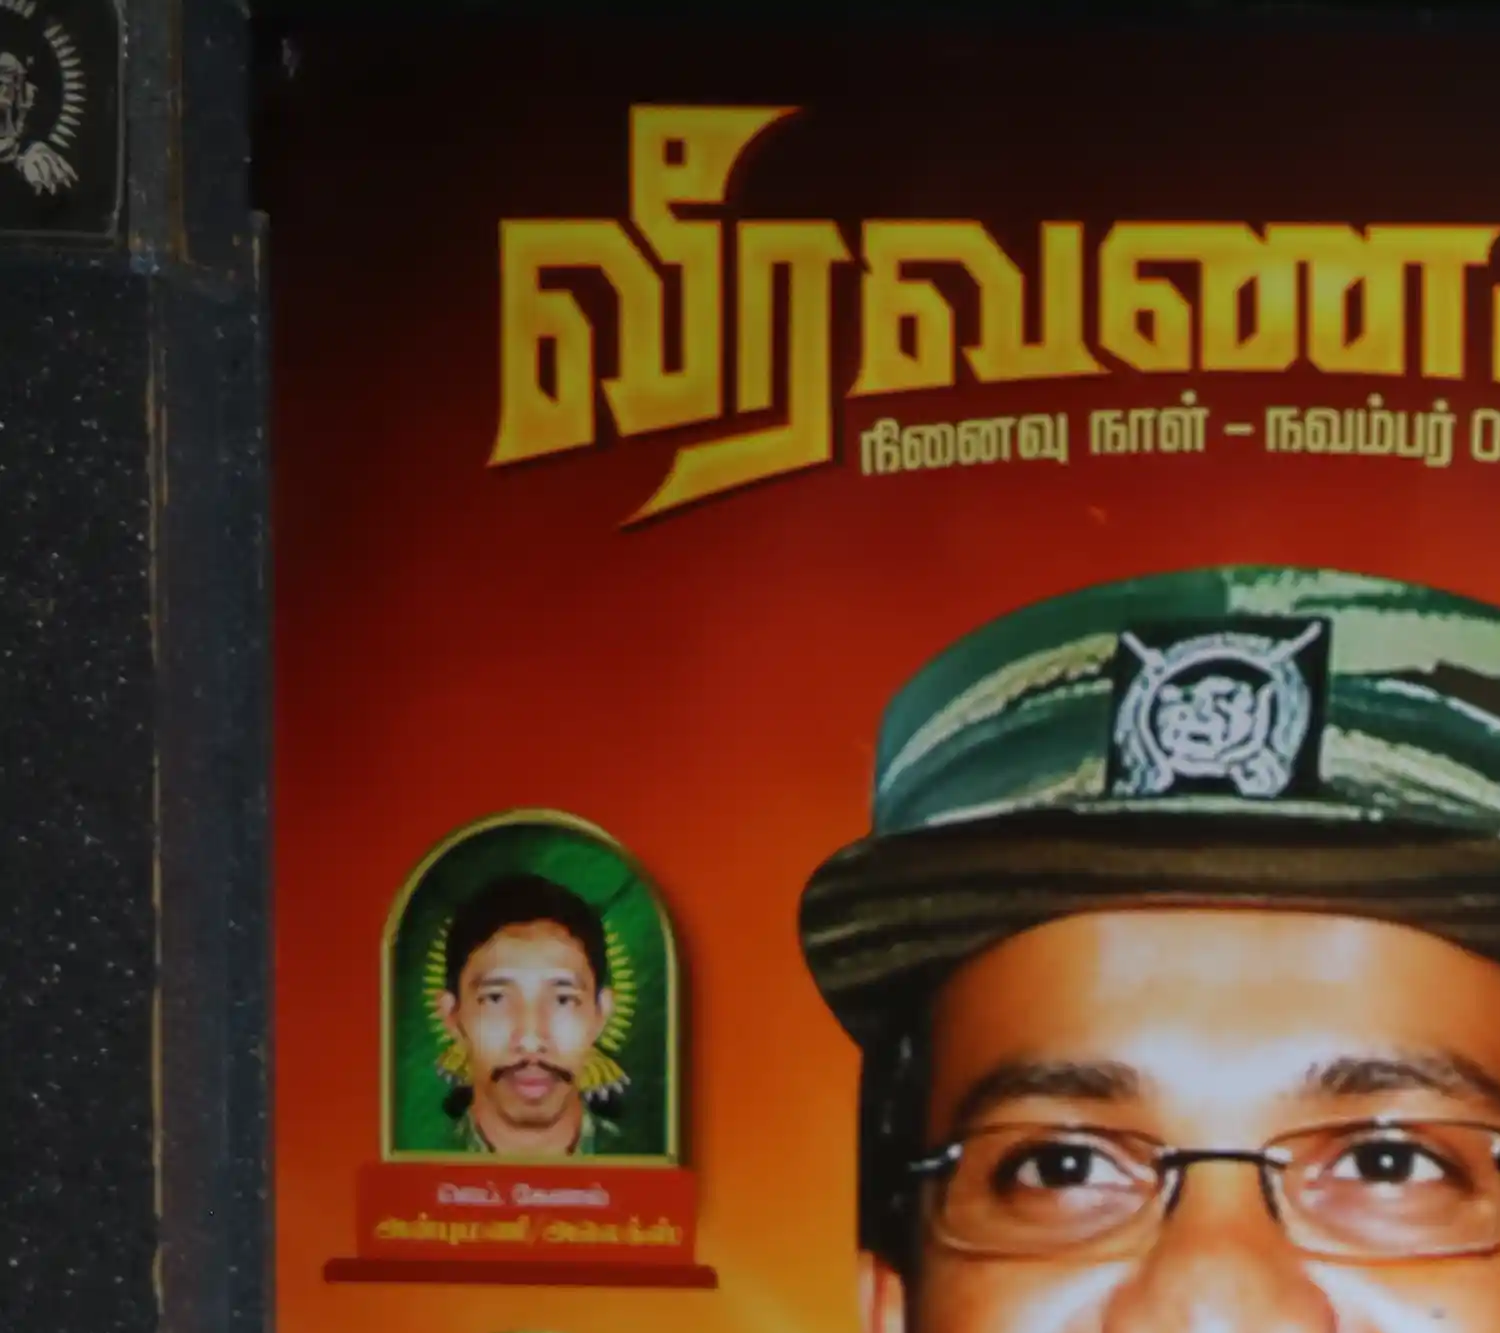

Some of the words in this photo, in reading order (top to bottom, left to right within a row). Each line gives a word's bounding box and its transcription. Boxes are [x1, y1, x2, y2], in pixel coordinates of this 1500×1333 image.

[860, 418, 1069, 476] நினைவு
[1090, 391, 1208, 455] நாள்
[1266, 394, 1456, 468] நவம்பர்
